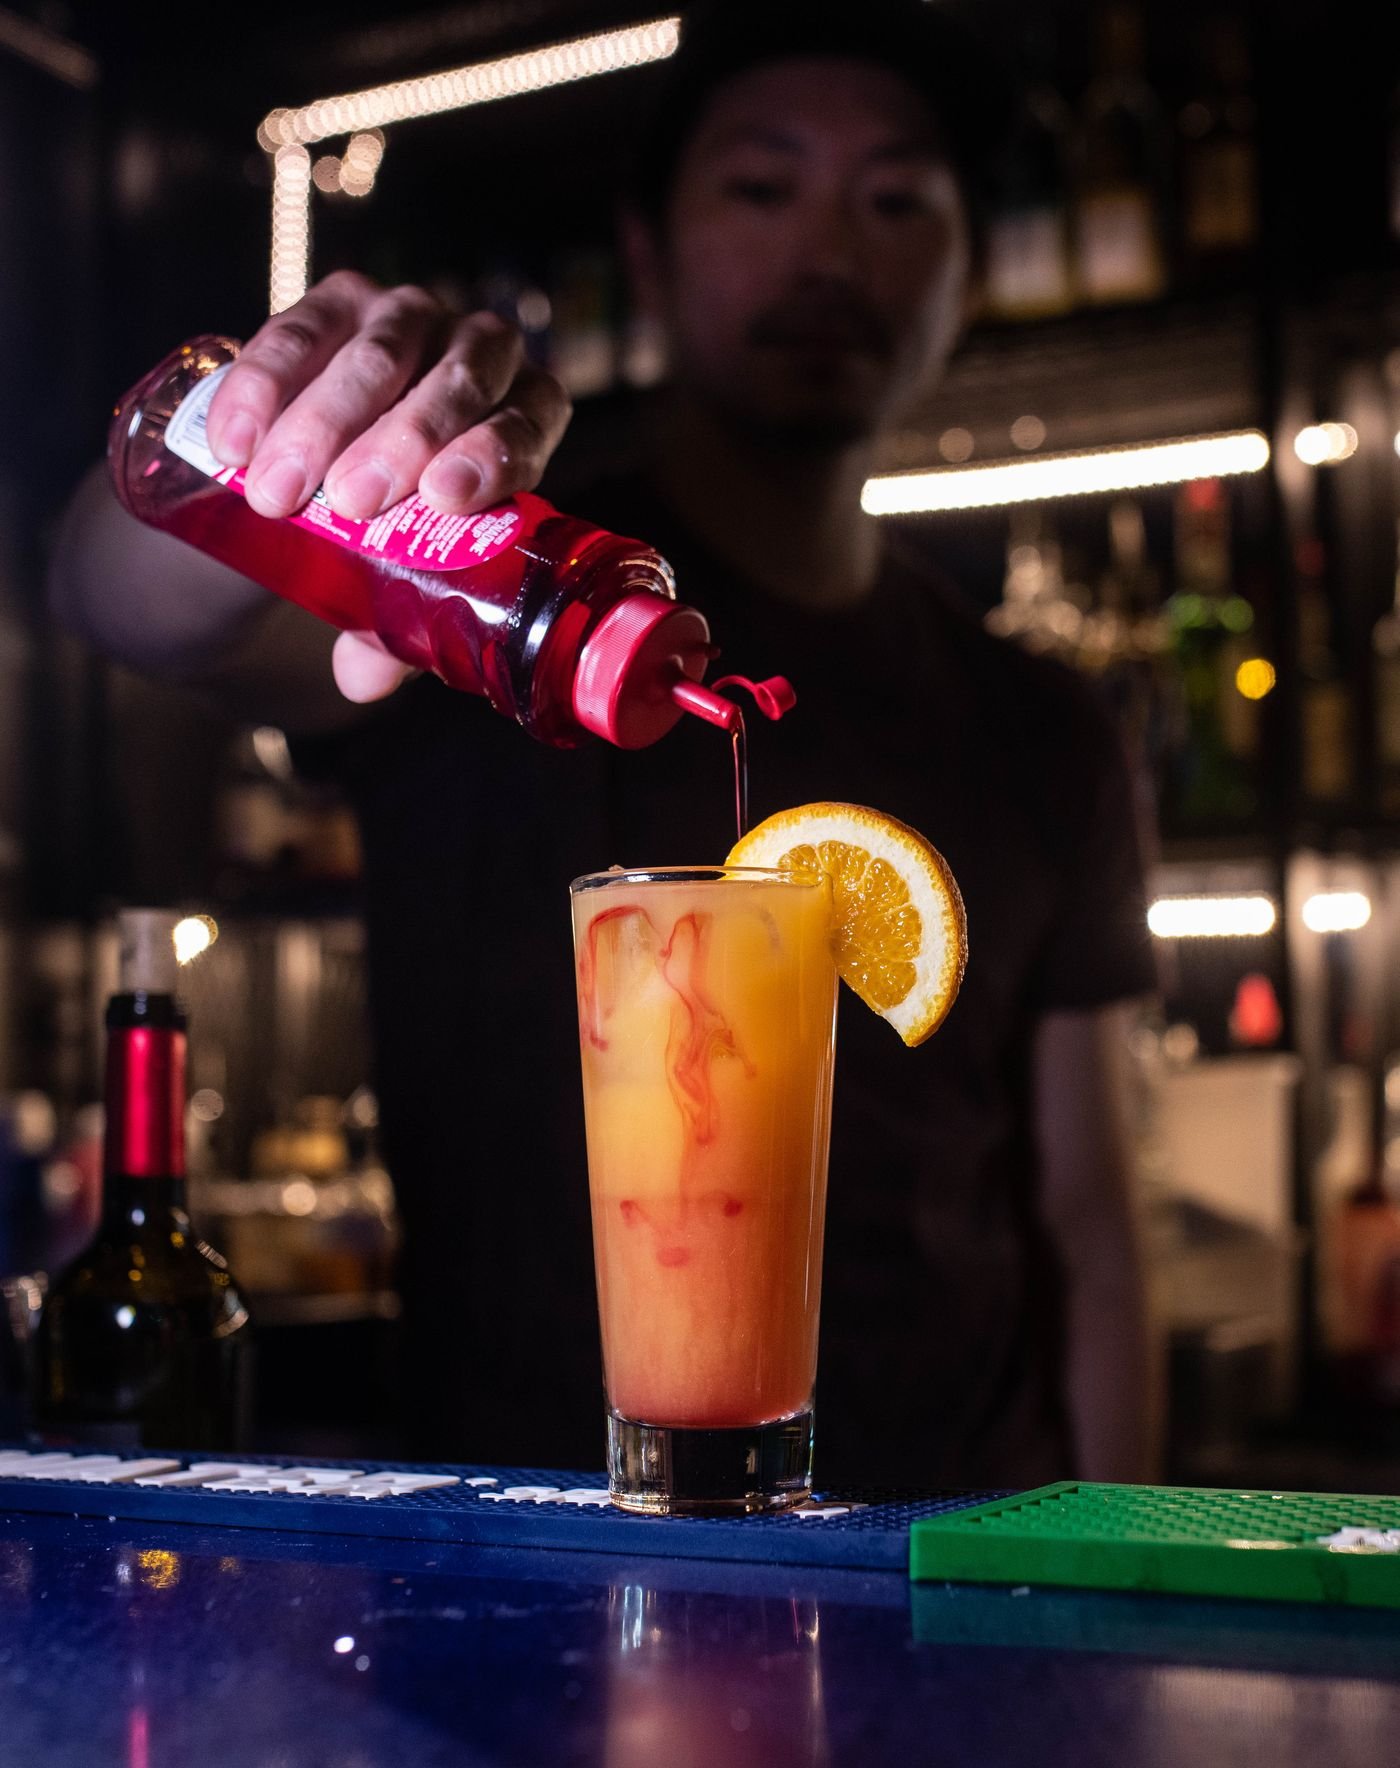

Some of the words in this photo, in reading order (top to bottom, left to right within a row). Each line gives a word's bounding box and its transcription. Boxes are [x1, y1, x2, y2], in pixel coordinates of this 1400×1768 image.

[396, 509, 417, 534] JUICE
[469, 512, 519, 556] GRENADINE
[471, 514, 497, 538] SYRUP
